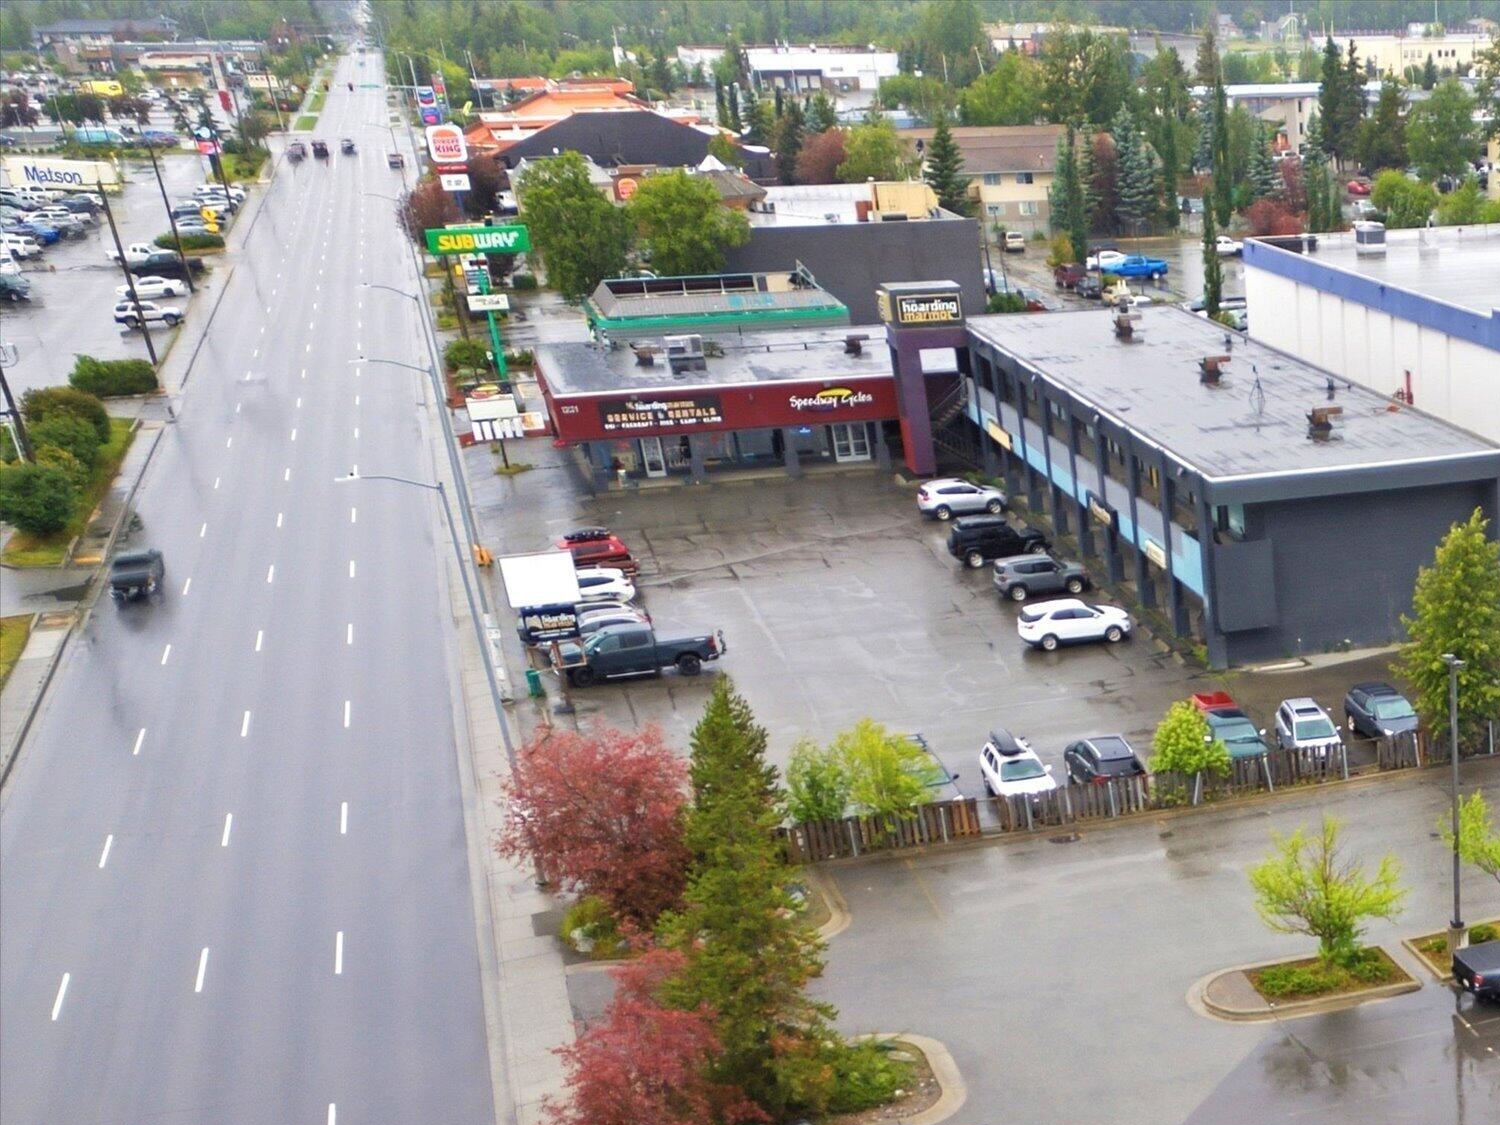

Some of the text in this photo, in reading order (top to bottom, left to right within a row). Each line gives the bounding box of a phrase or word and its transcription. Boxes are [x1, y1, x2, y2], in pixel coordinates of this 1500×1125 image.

[435, 144, 462, 153] KING
[23, 165, 83, 184] Matson
[438, 231, 519, 250] SUBWAY
[901, 299, 957, 313] hoarding
[789, 391, 873, 410] Speedway Cycles
[607, 412, 654, 423] SERVICE
[667, 407, 717, 419] RENTALS
